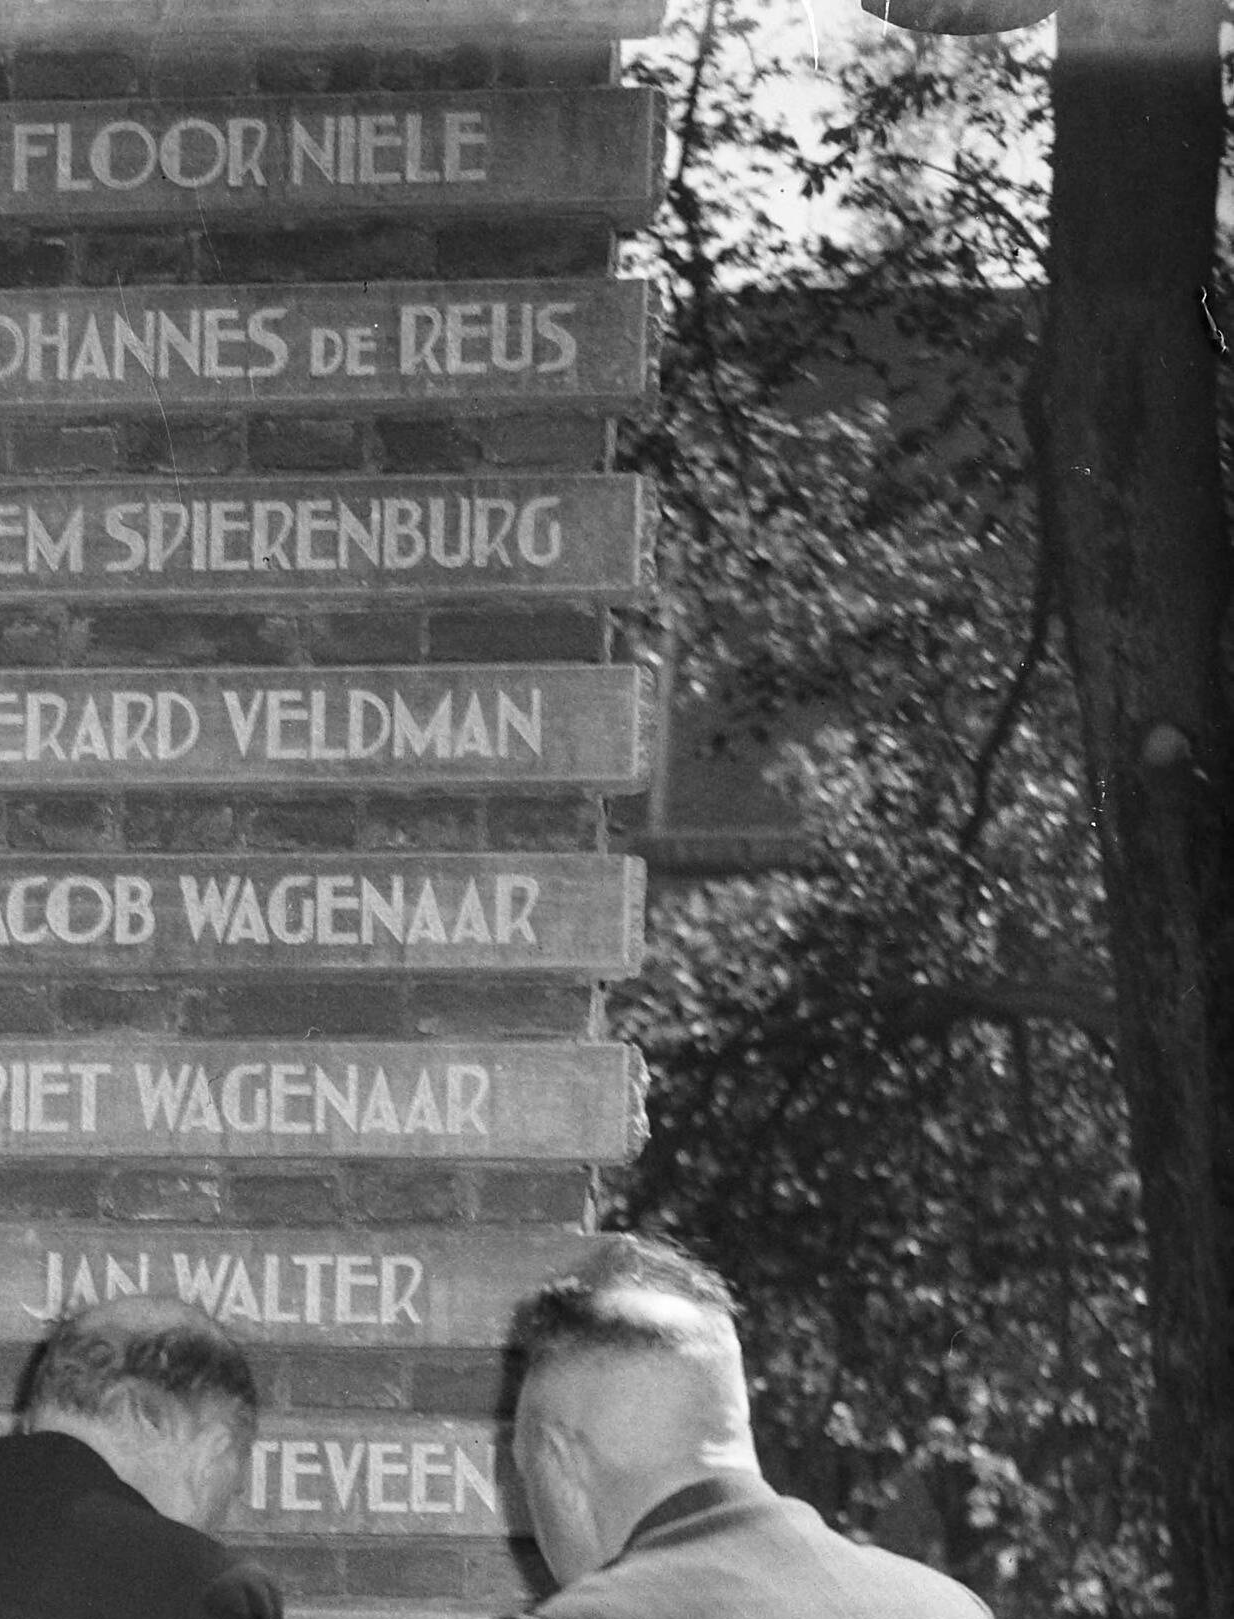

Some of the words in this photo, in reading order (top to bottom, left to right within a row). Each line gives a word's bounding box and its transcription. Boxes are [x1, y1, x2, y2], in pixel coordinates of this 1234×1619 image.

[11, 117, 270, 193] FLOOR
[290, 111, 489, 186] NIELE
[310, 327, 380, 377] DE
[400, 301, 578, 375] REUS
[105, 496, 564, 573] SPIERENBURG
[223, 688, 544, 761] VELDMAN
[179, 874, 541, 945] WAGENAAR
[135, 1063, 491, 1136] WAGENAAR
[22, 1251, 150, 1320] JAN
[172, 1252, 424, 1325] WALTER
